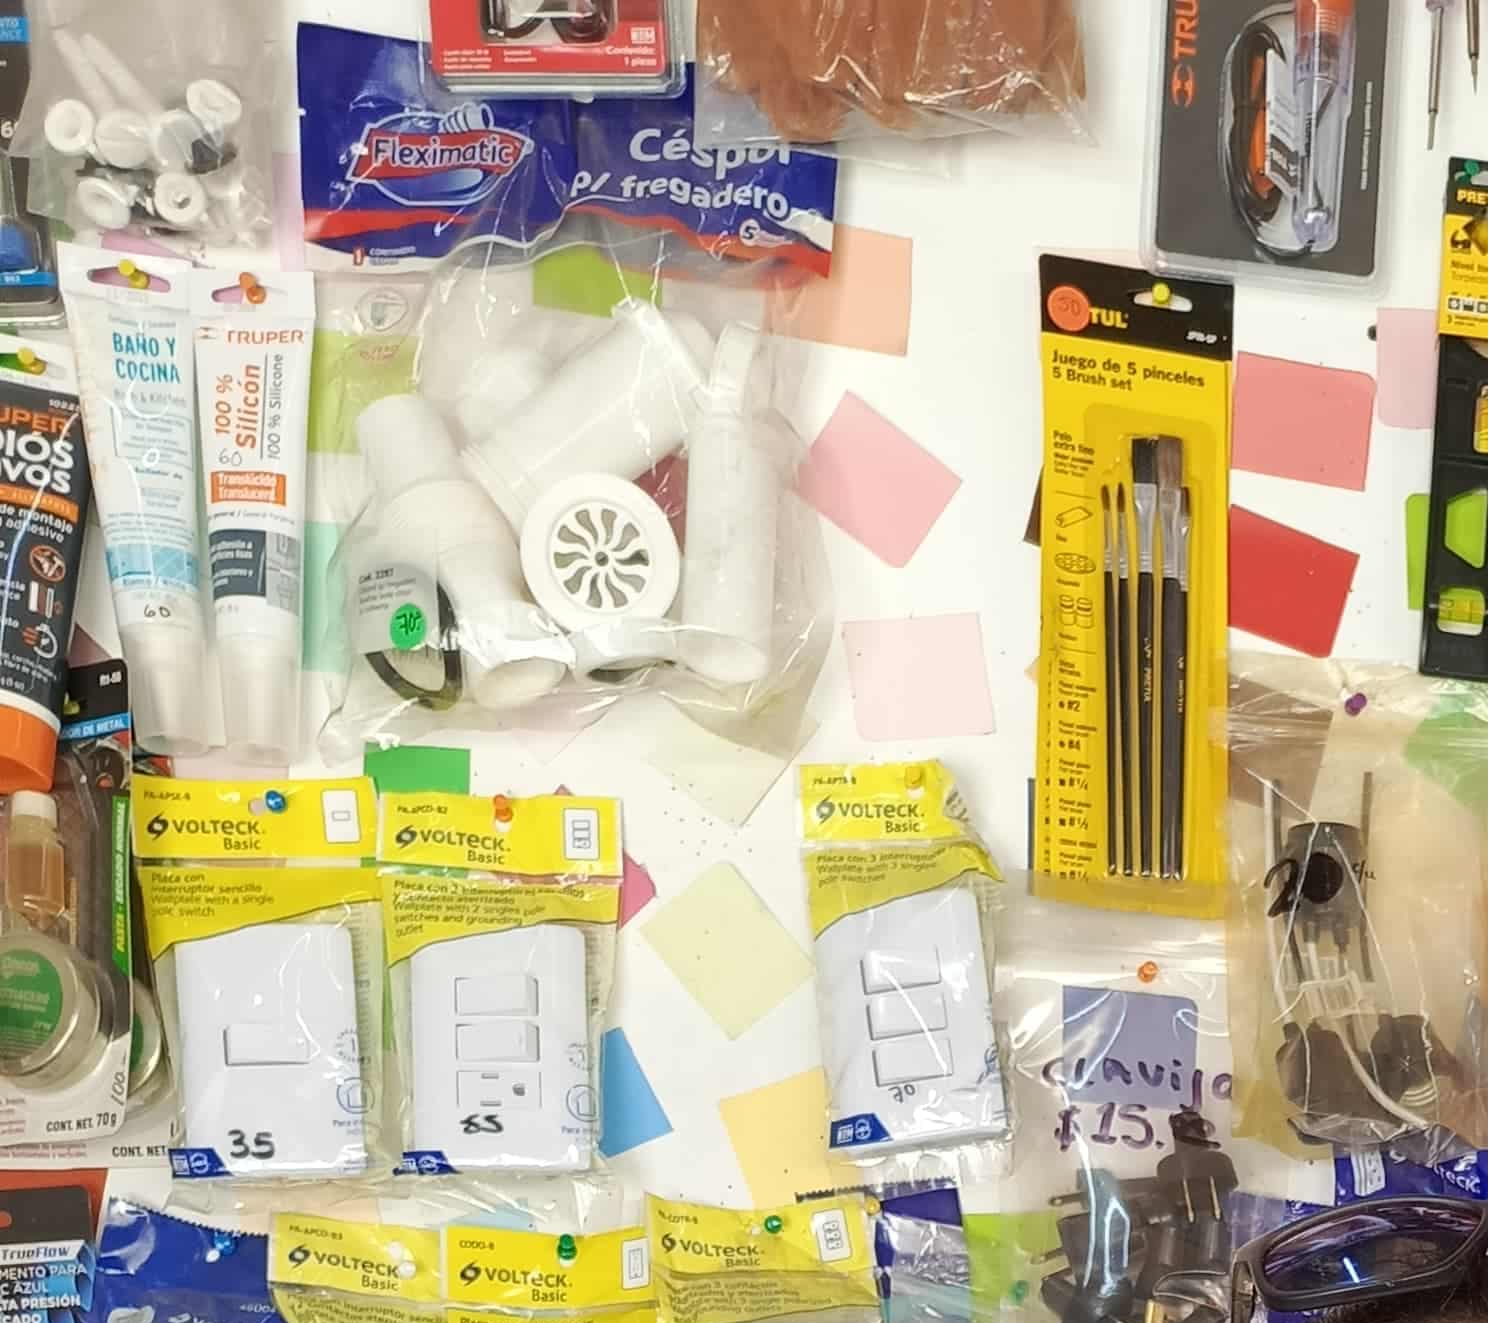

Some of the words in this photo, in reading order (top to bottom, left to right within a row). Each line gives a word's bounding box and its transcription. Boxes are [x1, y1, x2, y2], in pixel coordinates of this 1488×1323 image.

[373, 137, 515, 169] Fleximatic
[571, 171, 610, 197] p/
[620, 175, 788, 217] fregadero
[113, 332, 164, 357] BAÑO
[165, 338, 175, 355] Y
[226, 329, 304, 345] TRUPER
[116, 359, 180, 384] COCINA
[1052, 350, 1097, 369] Juego
[1103, 358, 1120, 373] de
[1128, 363, 1137, 375] 5
[1143, 366, 1205, 387] pinceles
[272, 354, 284, 413] Silicone
[1053, 366, 1061, 378] 5
[1067, 369, 1106, 386] Brush
[1111, 379, 1132, 391] set
[235, 364, 261, 449] Silicón
[214, 399, 230, 435] 100
[218, 449, 243, 467] 60
[143, 604, 171, 618] 60
[885, 819, 920, 834] Basic
[224, 838, 261, 850] Basic
[467, 850, 505, 865] Basic
[152, 873, 181, 883] Placa
[184, 875, 205, 883] con
[394, 880, 423, 890] Placa
[219, 883, 263, 894] sencillo
[205, 895, 229, 904] with
[242, 894, 274, 905] single
[179, 906, 215, 917] switch
[465, 913, 523, 926] grounding
[226, 1130, 276, 1161] 35
[50, 1263, 88, 1276] PARA
[725, 1258, 760, 1267] Basic
[13, 1281, 48, 1294] AZUL
[361, 1275, 399, 1291] Basic
[21, 1294, 81, 1309] PRESIÓN
[532, 1289, 567, 1302] Basic
